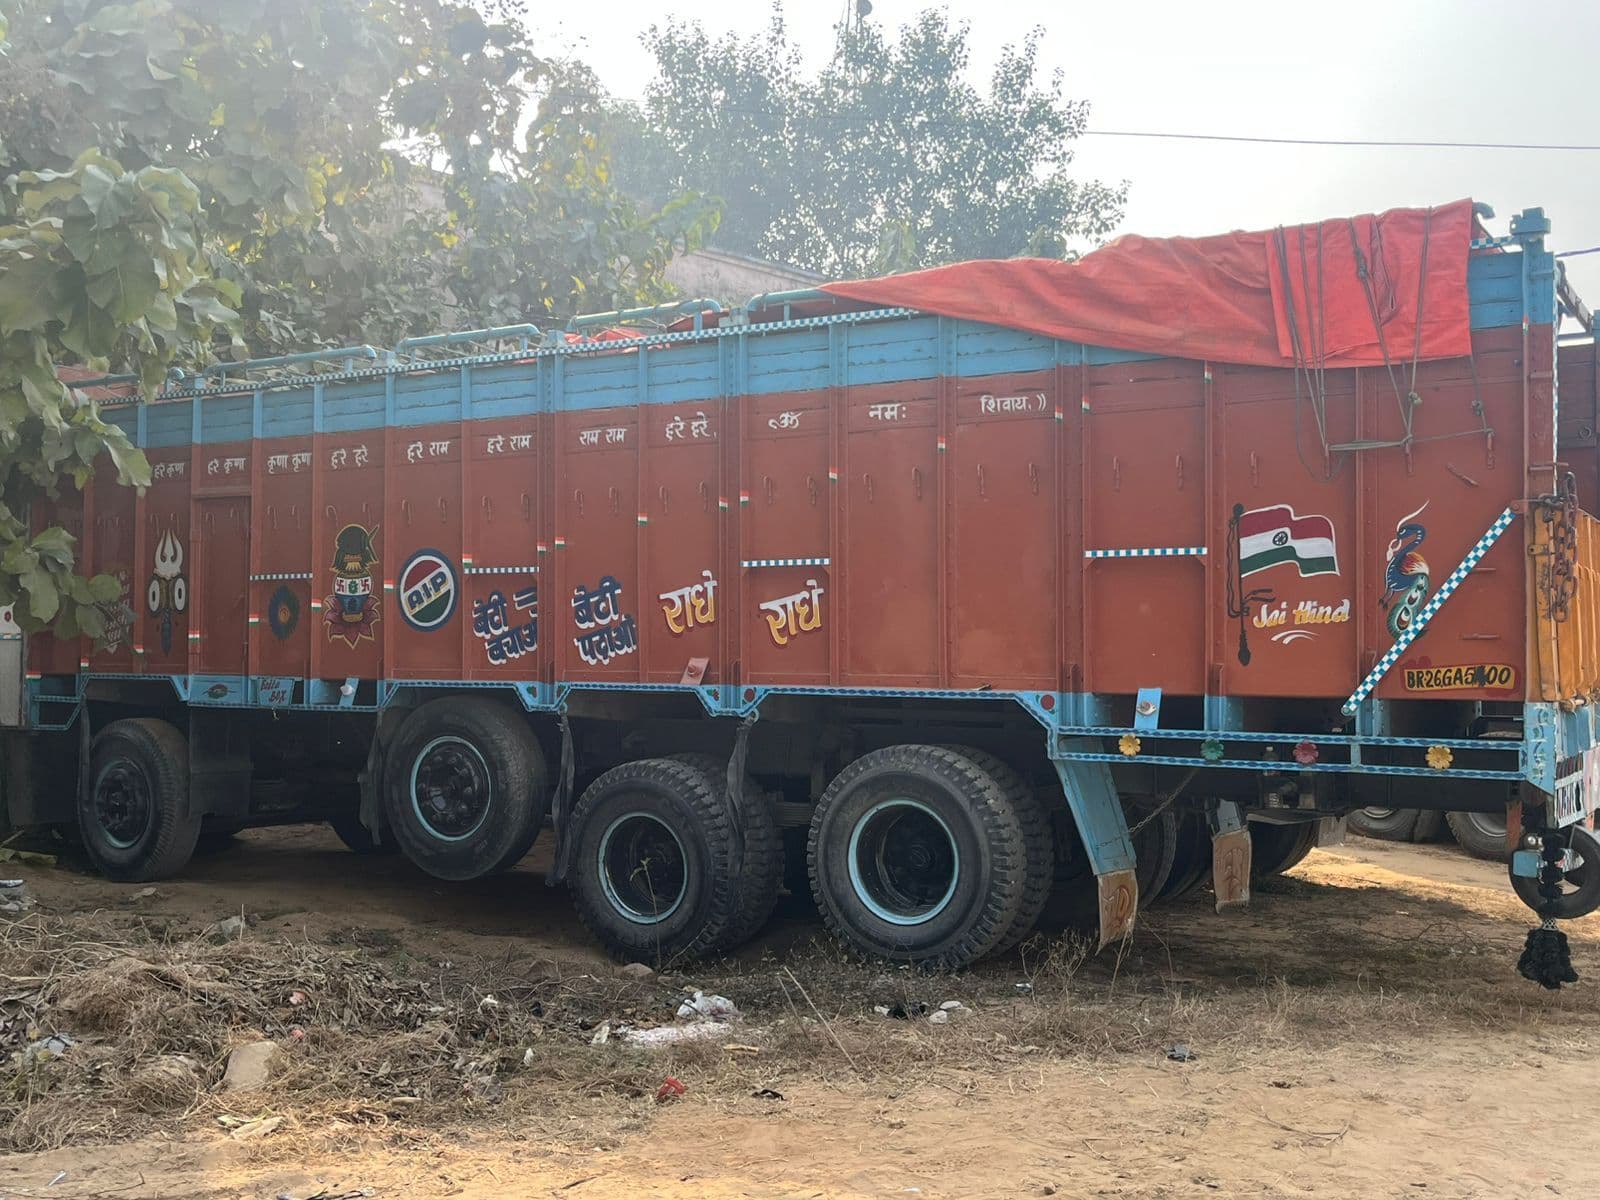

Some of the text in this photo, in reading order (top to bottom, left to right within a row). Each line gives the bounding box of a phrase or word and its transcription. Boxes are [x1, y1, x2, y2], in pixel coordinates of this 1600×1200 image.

[869, 403, 907, 420] नमः
[579, 428, 627, 446] राम राम
[665, 415, 685, 442] हरे
[407, 440, 450, 463] हरे राम
[487, 434, 532, 454] हरे राम
[659, 569, 718, 635] राधे
[759, 578, 824, 646] राधे
[1252, 598, 1351, 629] Jai Hind
